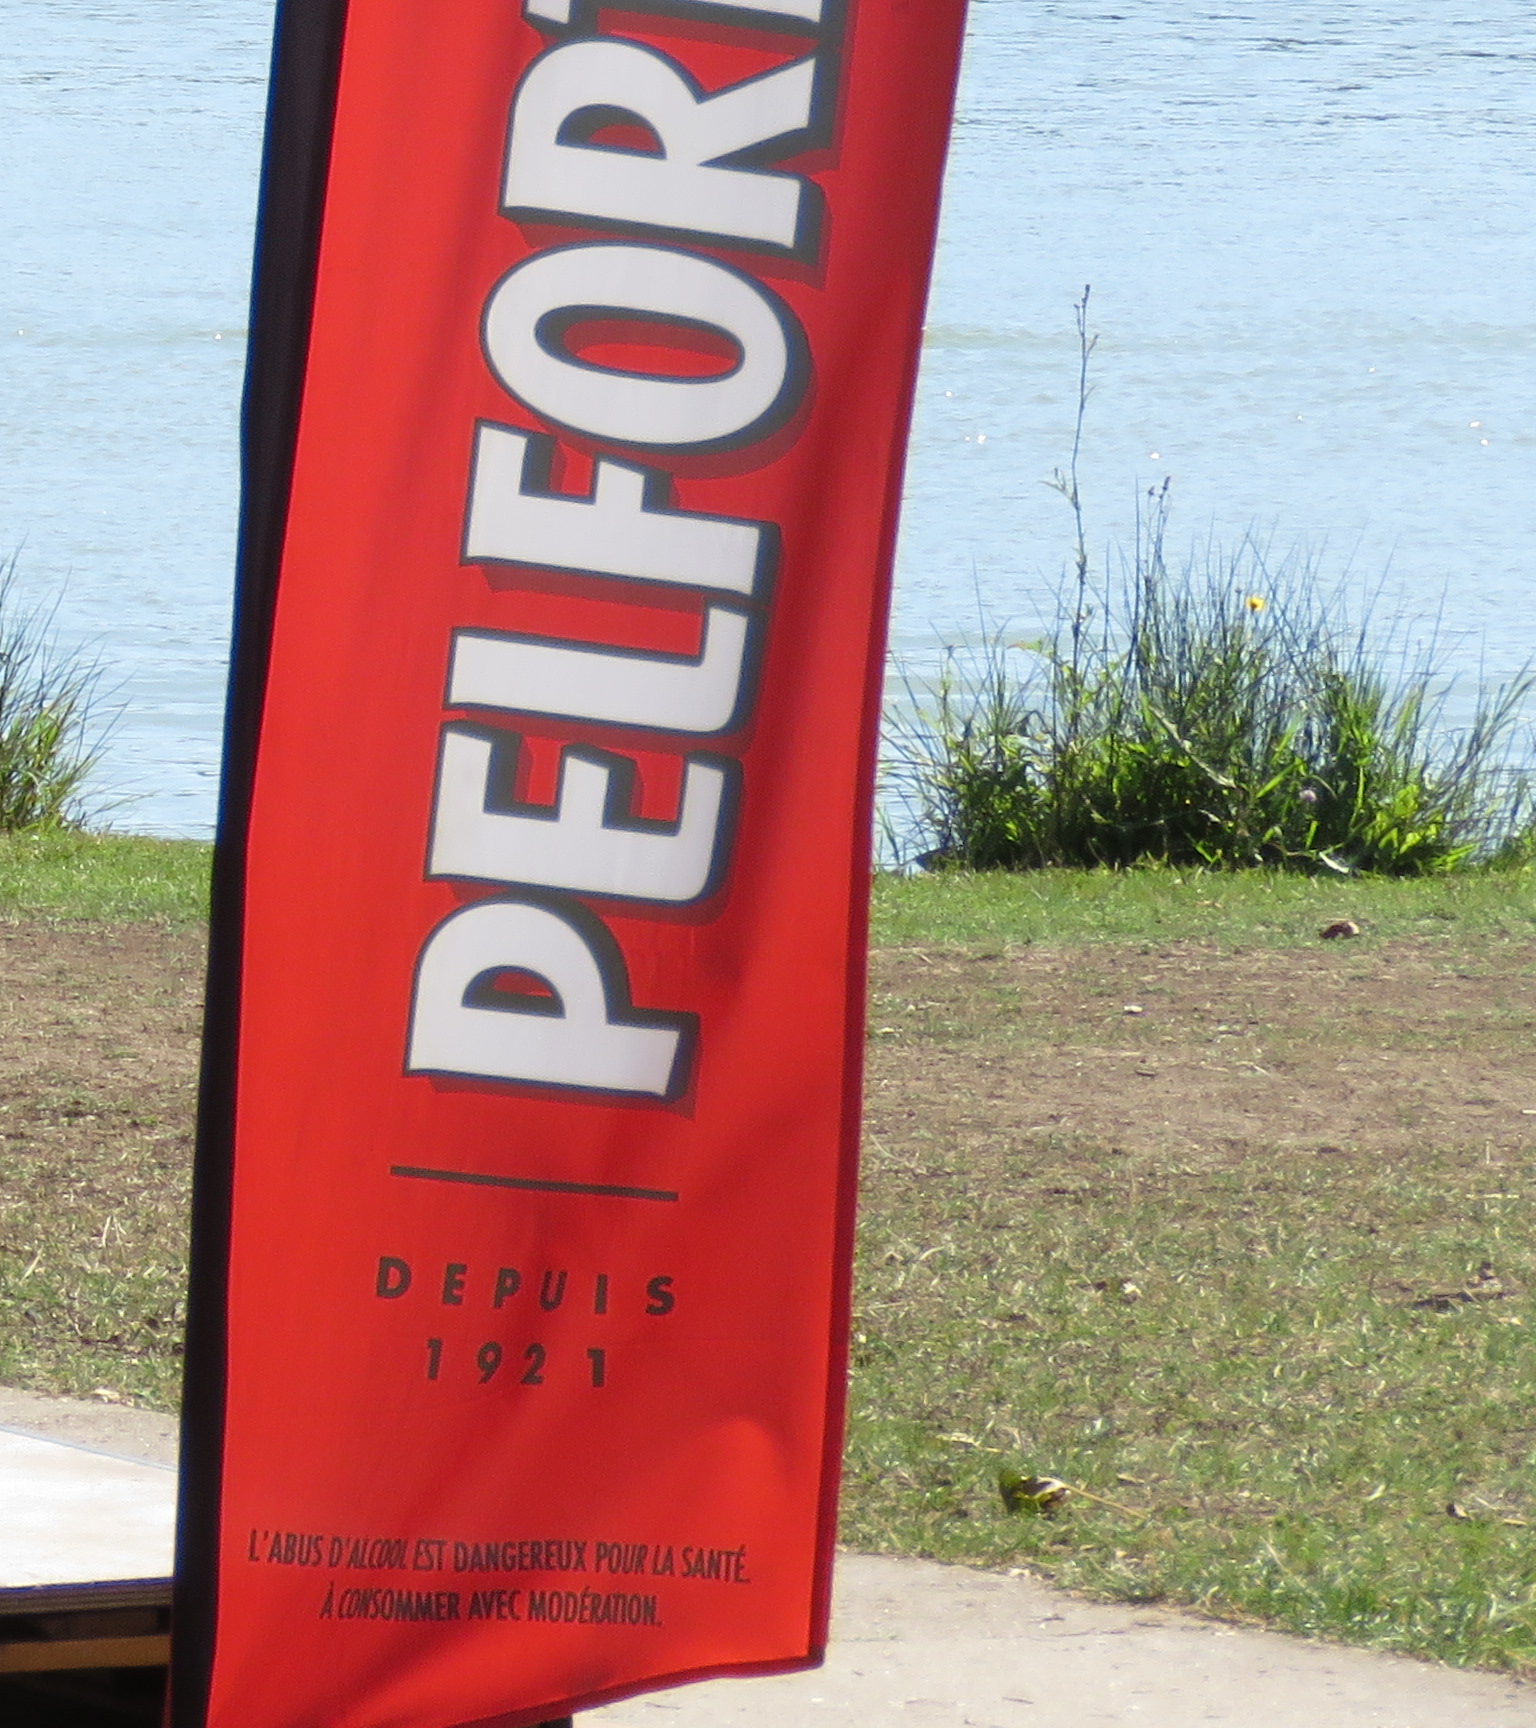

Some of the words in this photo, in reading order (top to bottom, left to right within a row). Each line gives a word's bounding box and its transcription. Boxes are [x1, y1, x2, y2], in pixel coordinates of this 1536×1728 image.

[376, 1255, 676, 1316] DEPUIS
[426, 1337, 606, 1388] 1921
[247, 1528, 324, 1568] L'ABUS
[328, 1535, 409, 1571] D'ALCOOL
[412, 1537, 447, 1572] EST
[452, 1538, 588, 1574] DANGEREUX
[594, 1540, 649, 1576] POUR
[651, 1543, 676, 1578] LA
[680, 1543, 752, 1584] SANTÉ.
[337, 1586, 460, 1622] CONSOMMER
[467, 1588, 521, 1621] AVEC
[528, 1584, 664, 1627] MODÉRATION.
